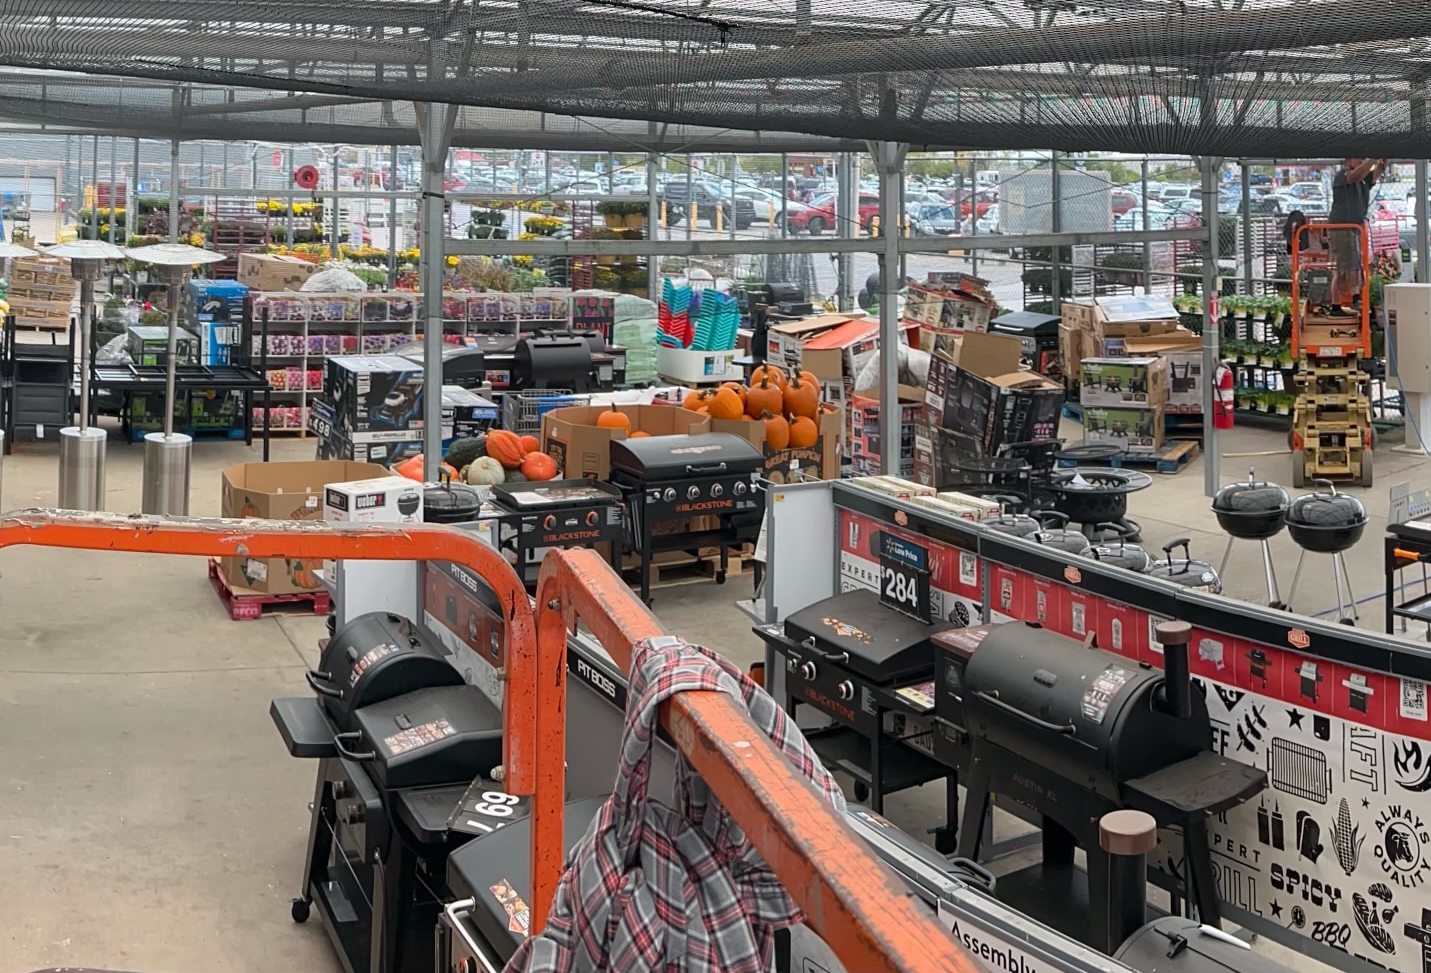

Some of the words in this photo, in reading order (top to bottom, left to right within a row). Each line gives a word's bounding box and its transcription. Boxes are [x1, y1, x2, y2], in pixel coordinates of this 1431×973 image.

[681, 499, 734, 512] BLACKSTONE
[548, 530, 600, 542] BLACKSTONE
[894, 547, 905, 557] Low
[905, 549, 918, 562] Price
[841, 561, 880, 585] EXPERT
[880, 564, 918, 608] $284
[1288, 633, 1309, 645] GRILL
[590, 668, 616, 698] BOSS
[809, 691, 856, 722] BLACKSTONE
[1011, 773, 1044, 794] AUSTIN
[1046, 788, 1060, 802] XL
[1374, 804, 1431, 846] ALWAYS
[1373, 843, 1431, 889] QUALITY
[1270, 862, 1343, 914] SPICY
[951, 920, 1037, 973] Assembly
[1311, 921, 1353, 946] BBQ
